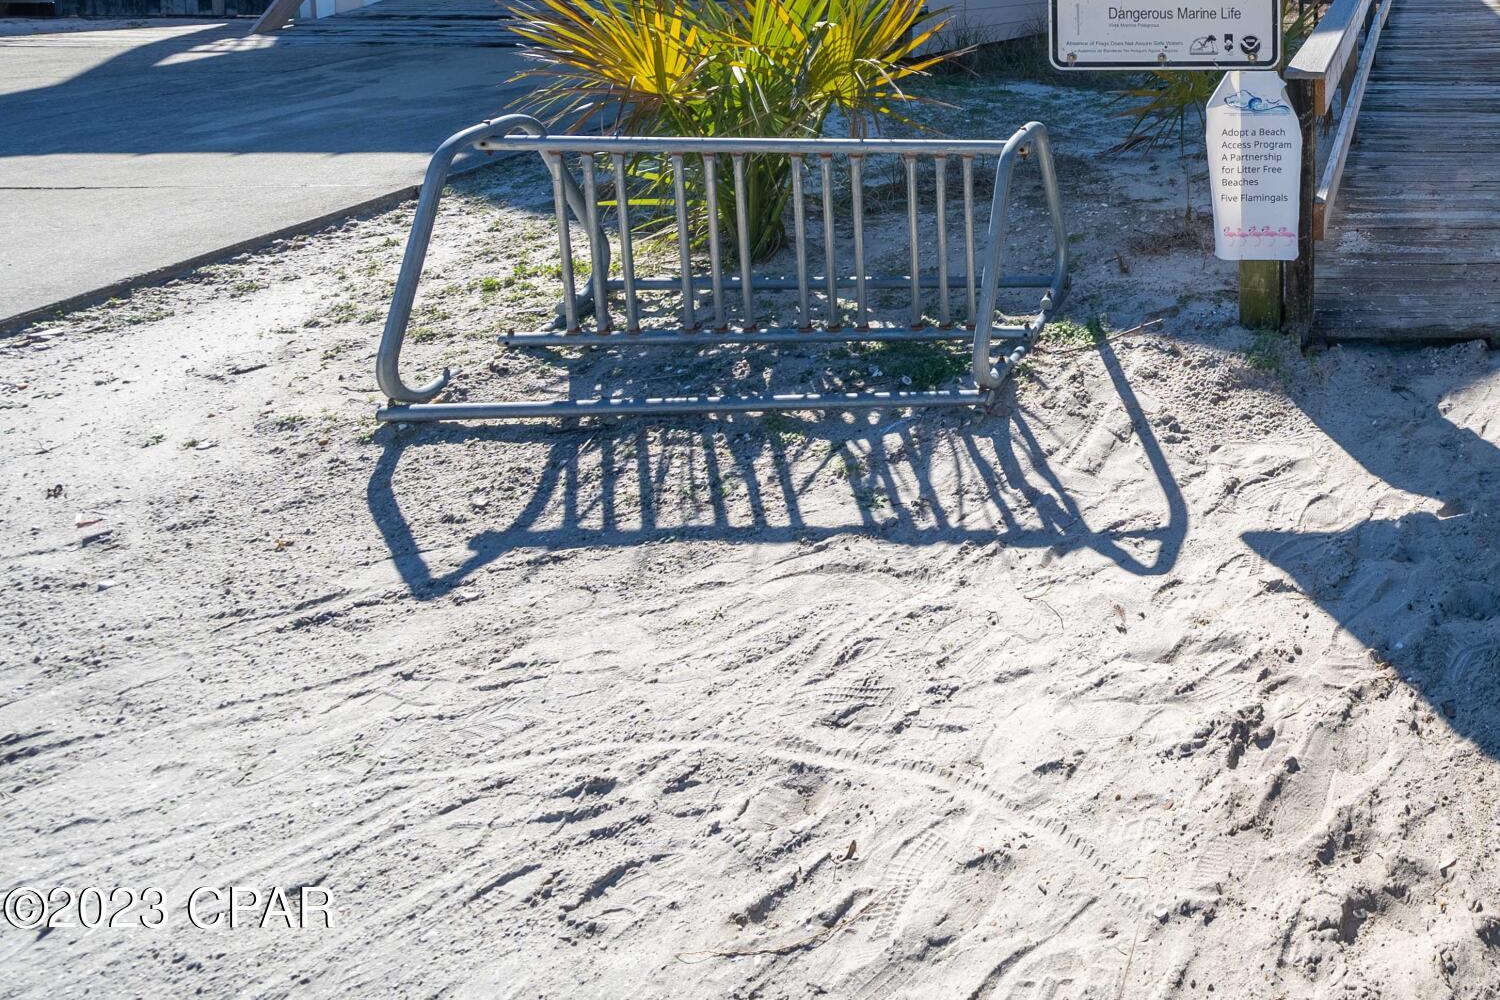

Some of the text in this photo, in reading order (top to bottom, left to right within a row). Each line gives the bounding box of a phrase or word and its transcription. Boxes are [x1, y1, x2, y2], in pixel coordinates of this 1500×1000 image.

[1109, 8, 1241, 22] Dangerous Marine Life
[1222, 129, 1249, 138] Adopt
[1259, 128, 1285, 136] Beach
[1222, 141, 1292, 150] Access Program
[1231, 154, 1281, 162] Partnership
[1222, 178, 1258, 186] Beaches
